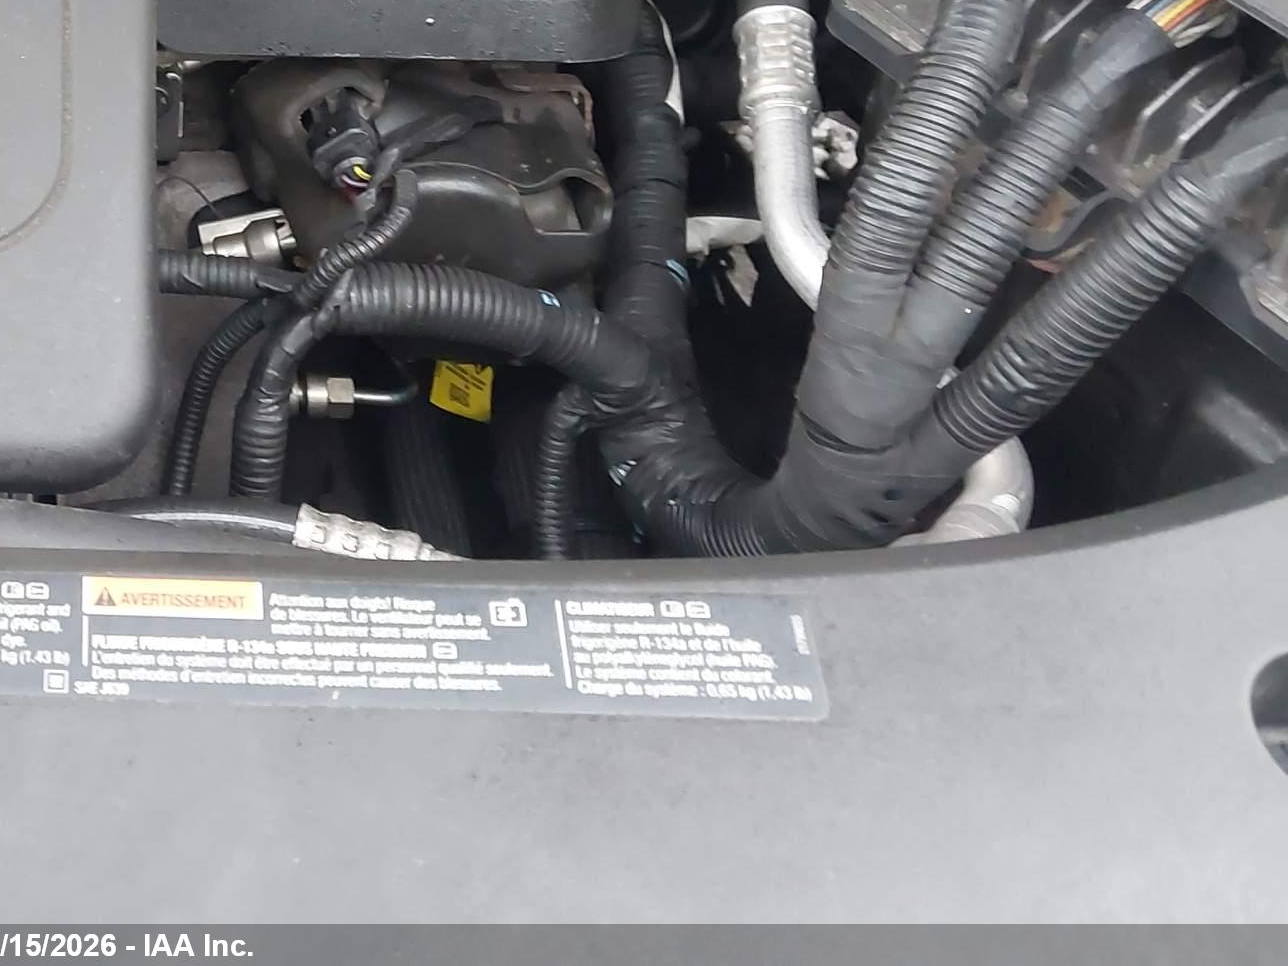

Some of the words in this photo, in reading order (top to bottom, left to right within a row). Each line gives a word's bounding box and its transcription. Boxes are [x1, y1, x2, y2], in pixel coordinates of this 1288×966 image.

[120, 592, 247, 609] AVERTISSEMENT
[46, 604, 70, 616] and
[1, 649, 18, 665] kg
